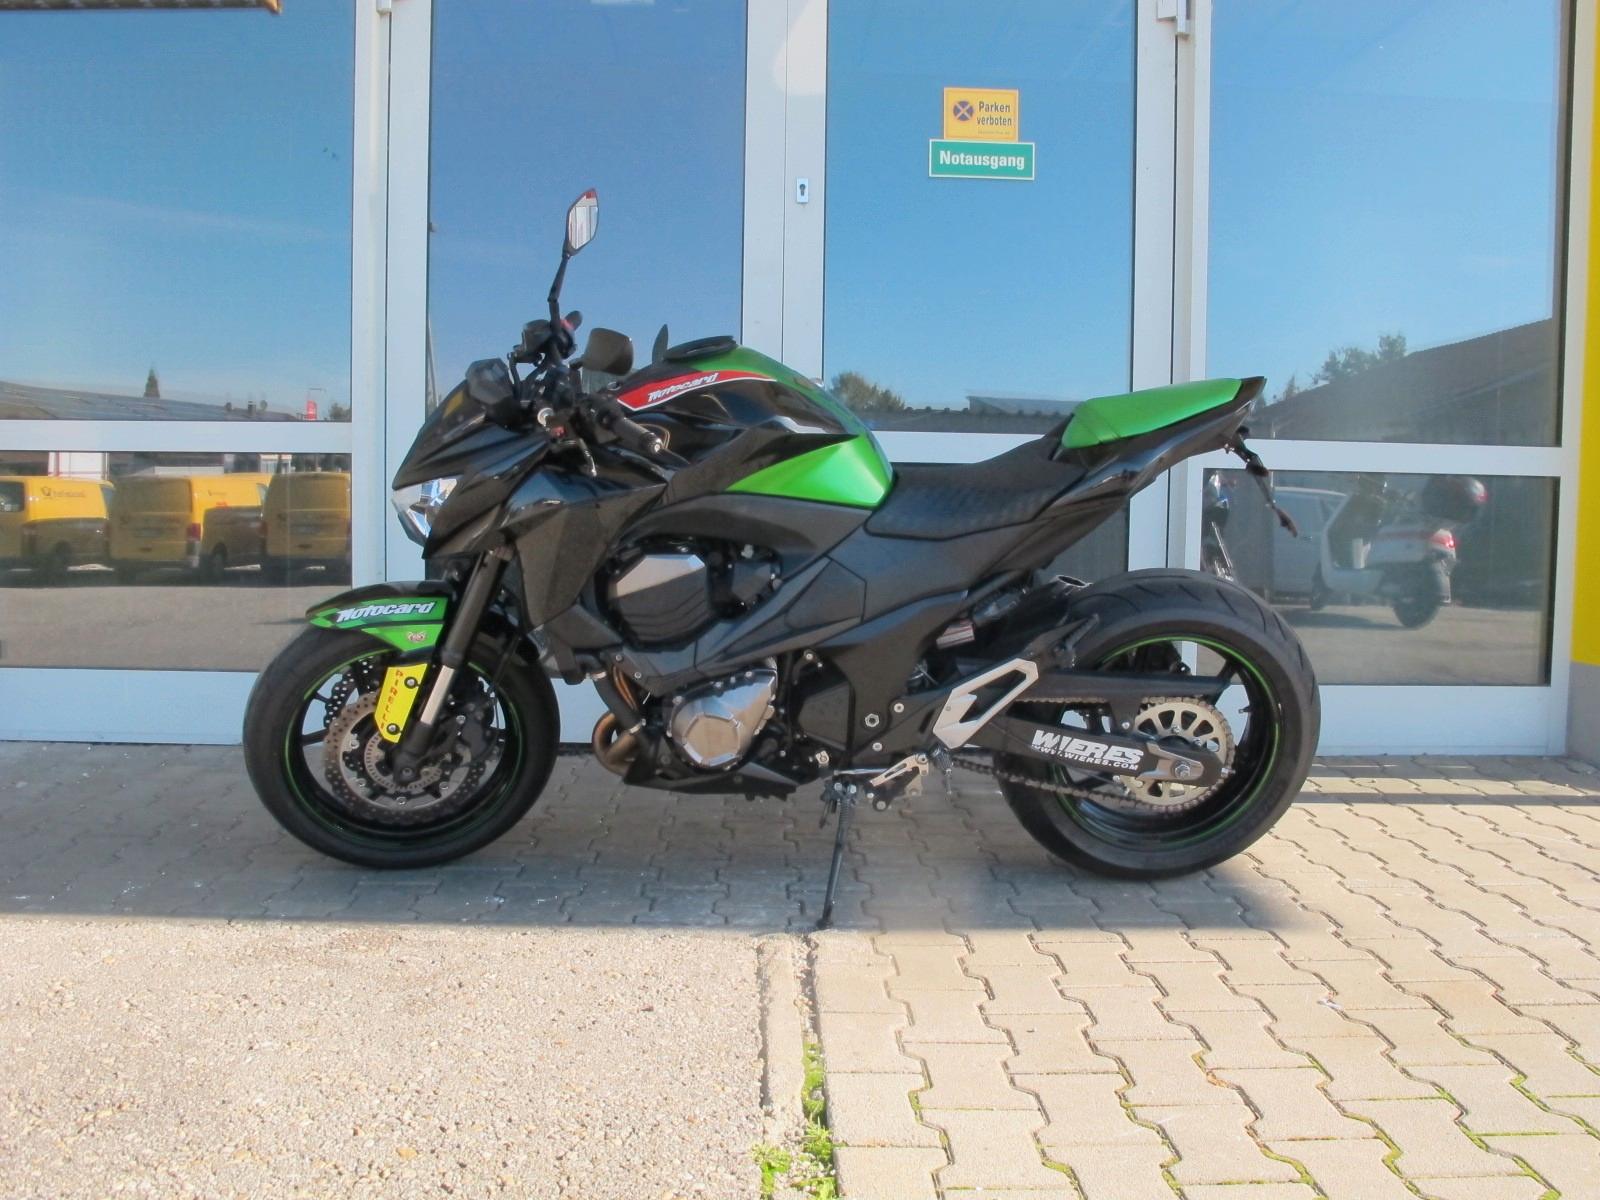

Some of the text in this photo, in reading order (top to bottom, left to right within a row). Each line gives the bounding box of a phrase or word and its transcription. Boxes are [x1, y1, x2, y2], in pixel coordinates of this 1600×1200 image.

[978, 101, 1010, 113] Parken
[976, 115, 1012, 126] verboten
[939, 150, 1025, 170] Notausgang
[647, 372, 719, 402] Motocard
[335, 602, 436, 624] Motocard
[1031, 729, 1145, 764] WIERES
